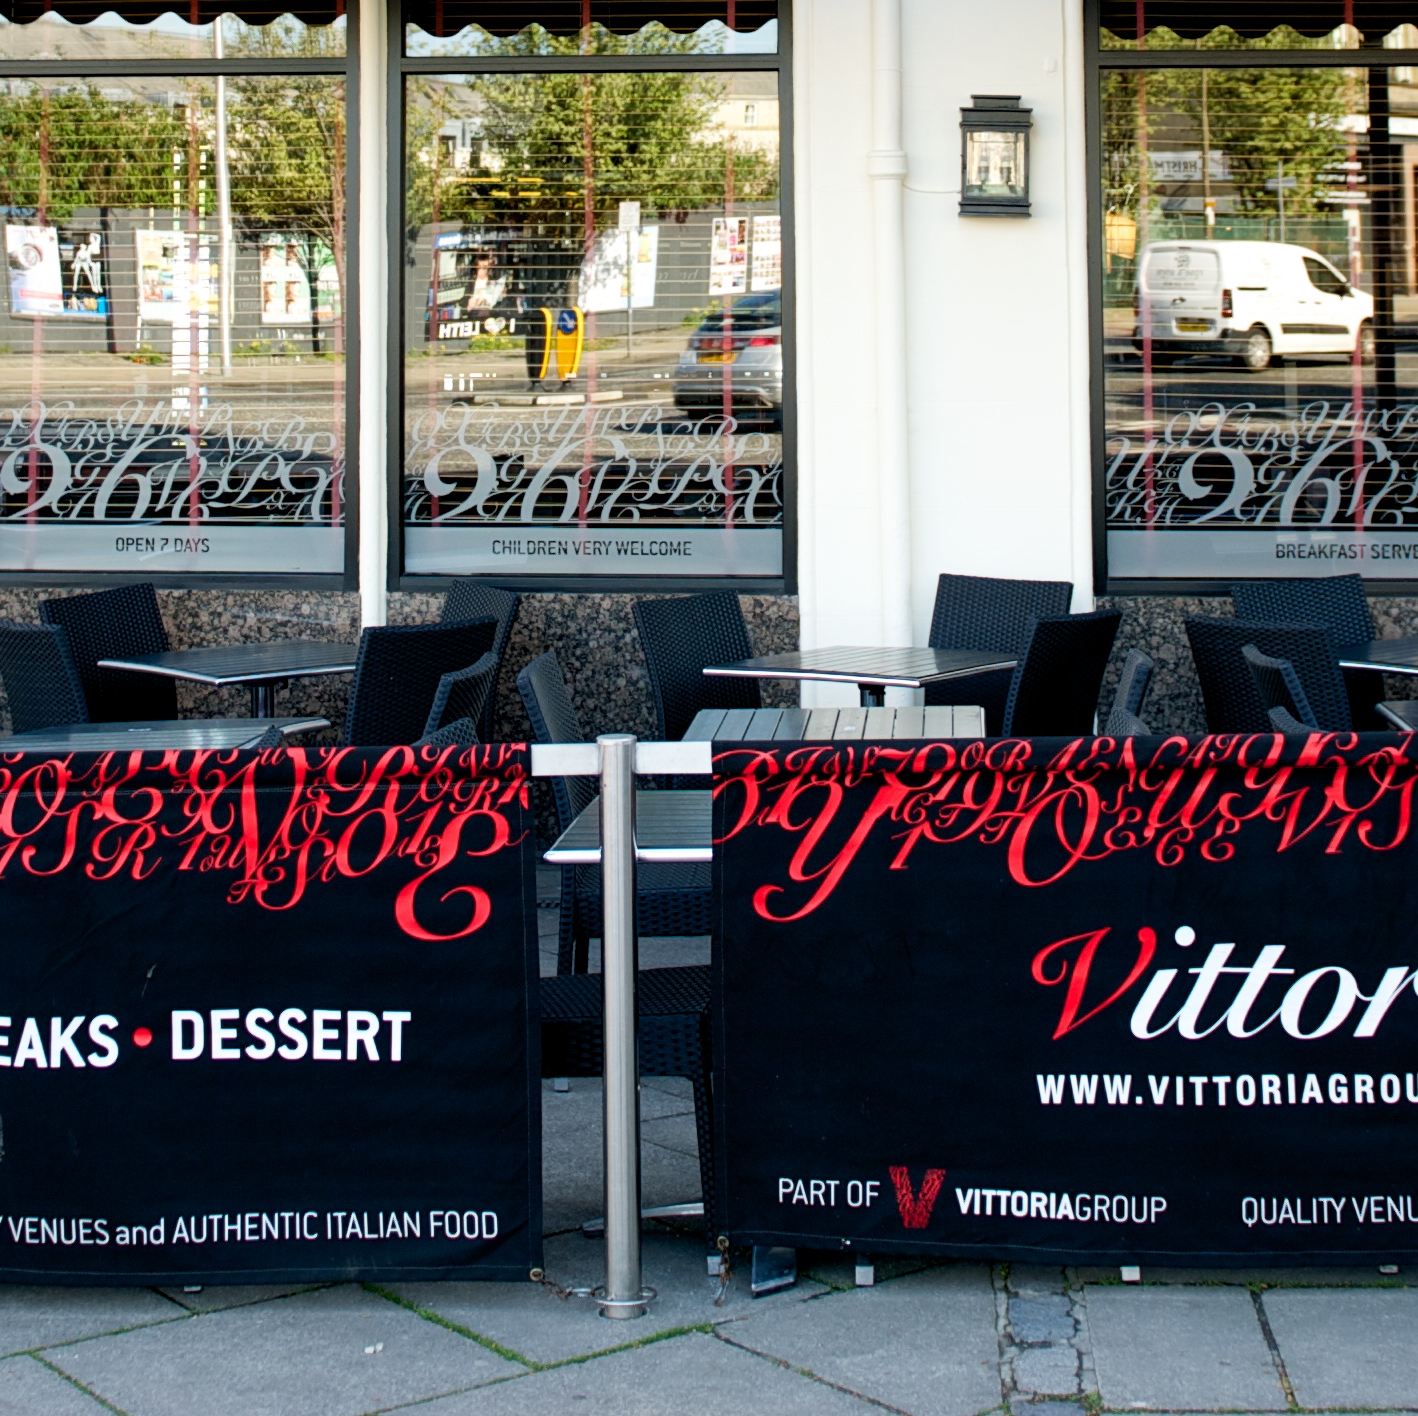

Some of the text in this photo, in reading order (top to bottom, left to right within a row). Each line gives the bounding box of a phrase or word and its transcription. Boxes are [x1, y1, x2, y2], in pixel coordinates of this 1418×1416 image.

[115, 537, 210, 553] OPEN 7 DAYS
[492, 539, 692, 556] CHILDREN VERY WELCOME
[1275, 543, 1367, 559] BREAKFAST
[171, 1008, 412, 1062] DESSERT
[778, 1177, 840, 1206] PART
[847, 1180, 880, 1207] OF
[955, 1188, 1167, 1223] VITTORIAGROUP
[1241, 1197, 1346, 1228] QUALITY
[8, 1216, 110, 1245] VENUES
[115, 1218, 165, 1245] and
[172, 1211, 318, 1244] AUTHENTIC
[326, 1211, 421, 1240] ITALIAN
[429, 1211, 498, 1239] FOOD
